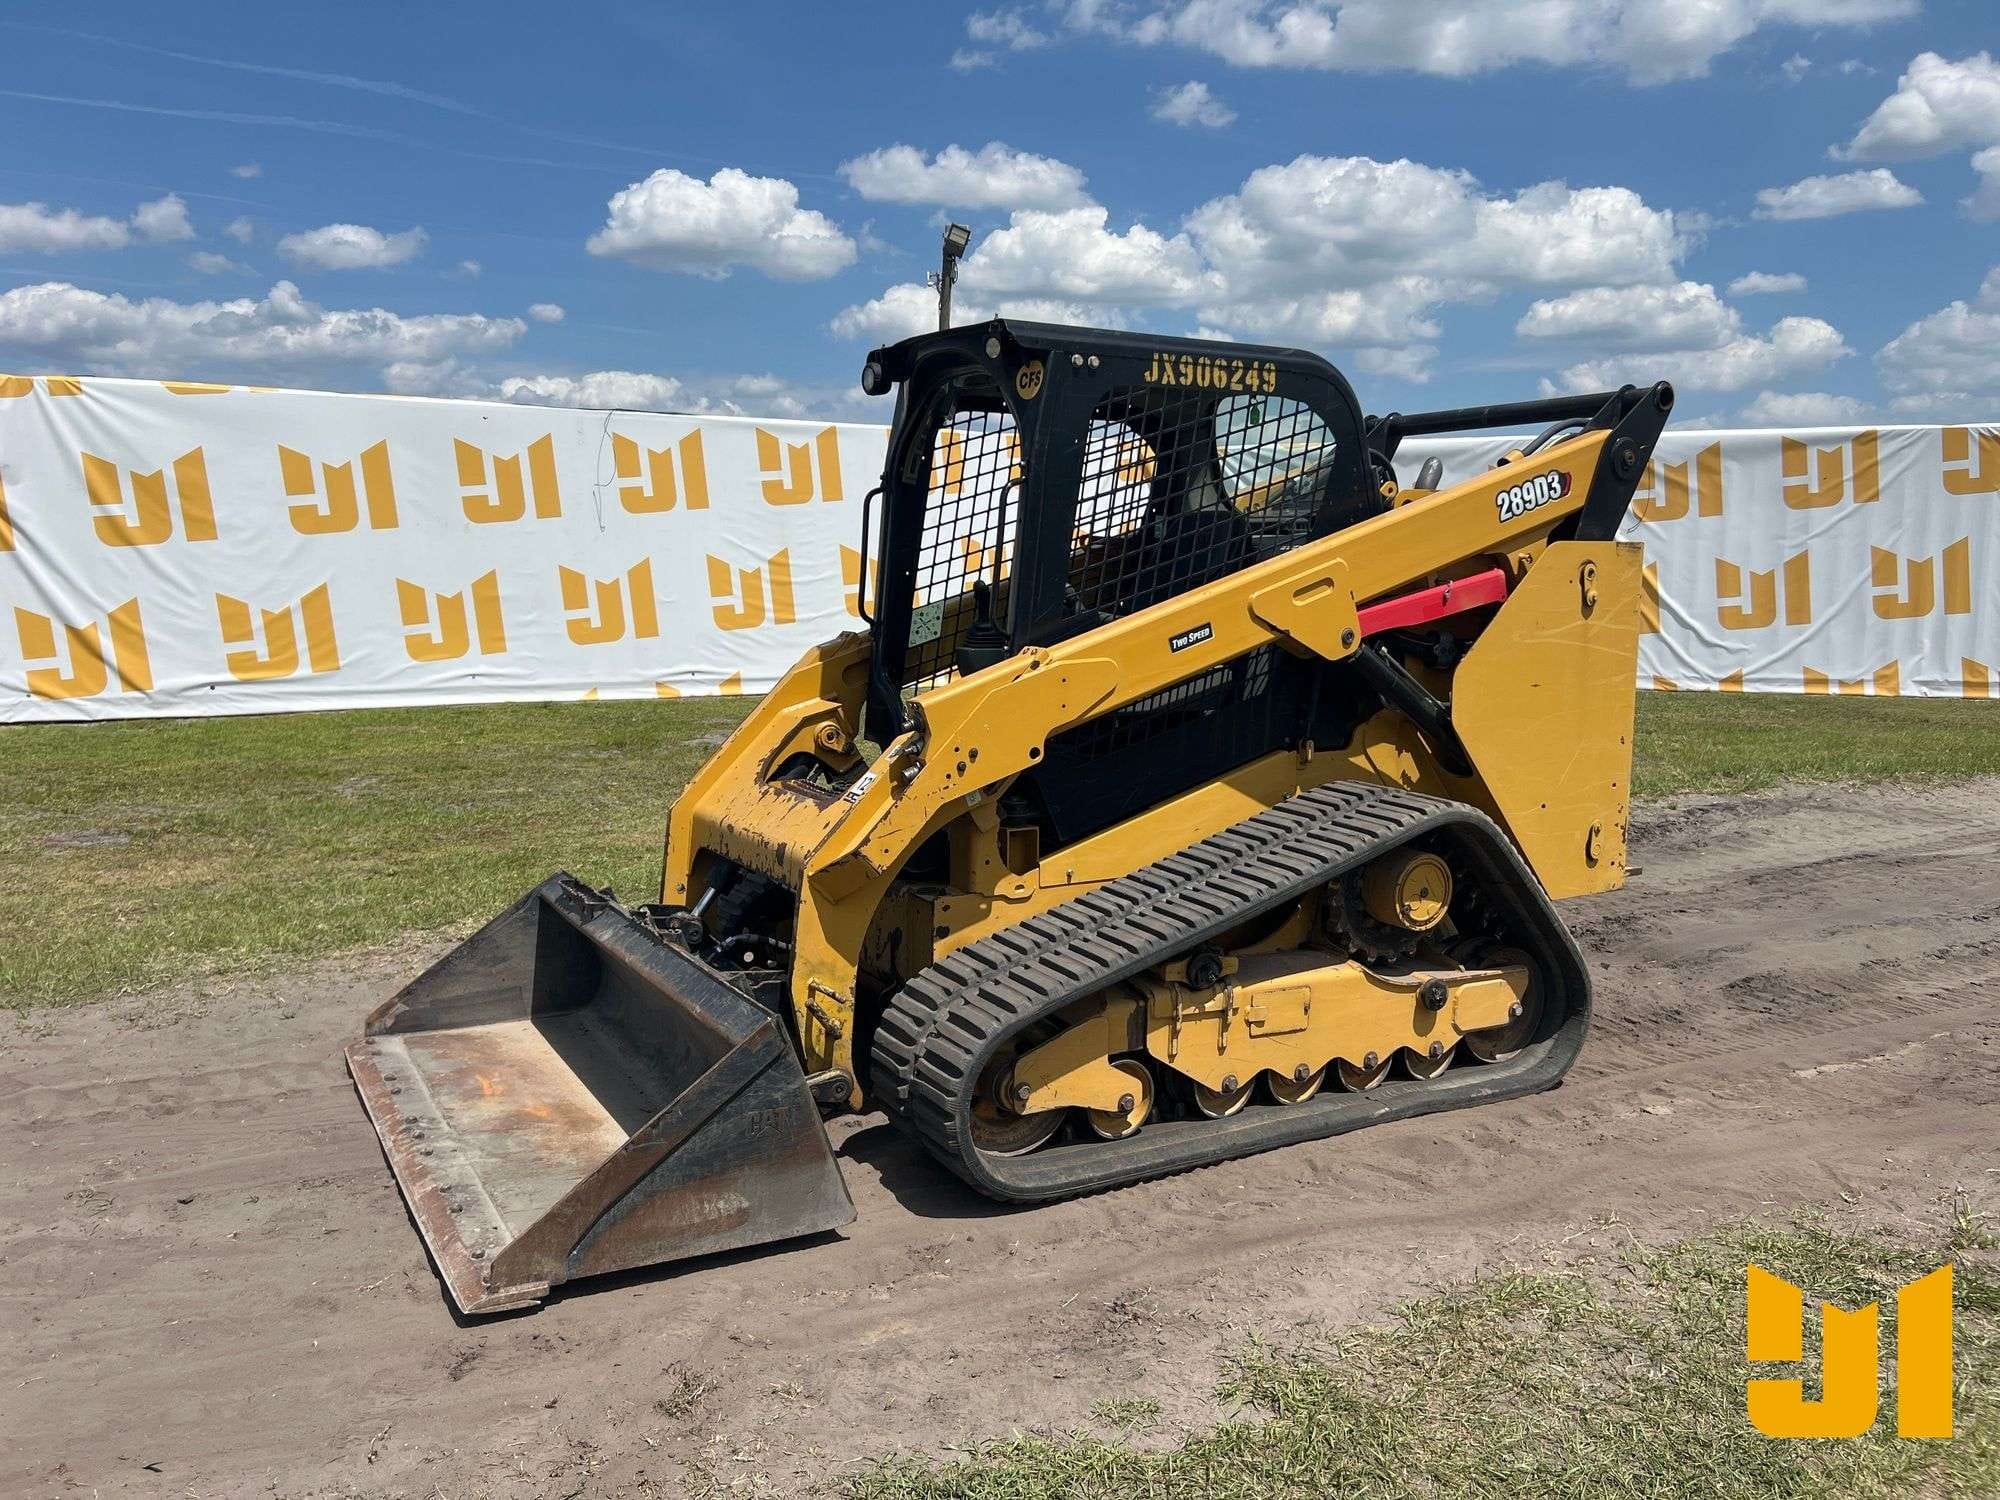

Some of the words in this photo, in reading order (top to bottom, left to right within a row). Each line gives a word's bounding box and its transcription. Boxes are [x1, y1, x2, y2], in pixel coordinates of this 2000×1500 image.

[1019, 369, 1042, 390] CFS
[1144, 352, 1277, 393] JX906249
[1497, 471, 1562, 522] 289D3
[1172, 637, 1188, 649] TWO
[1188, 628, 1210, 642] SPEED
